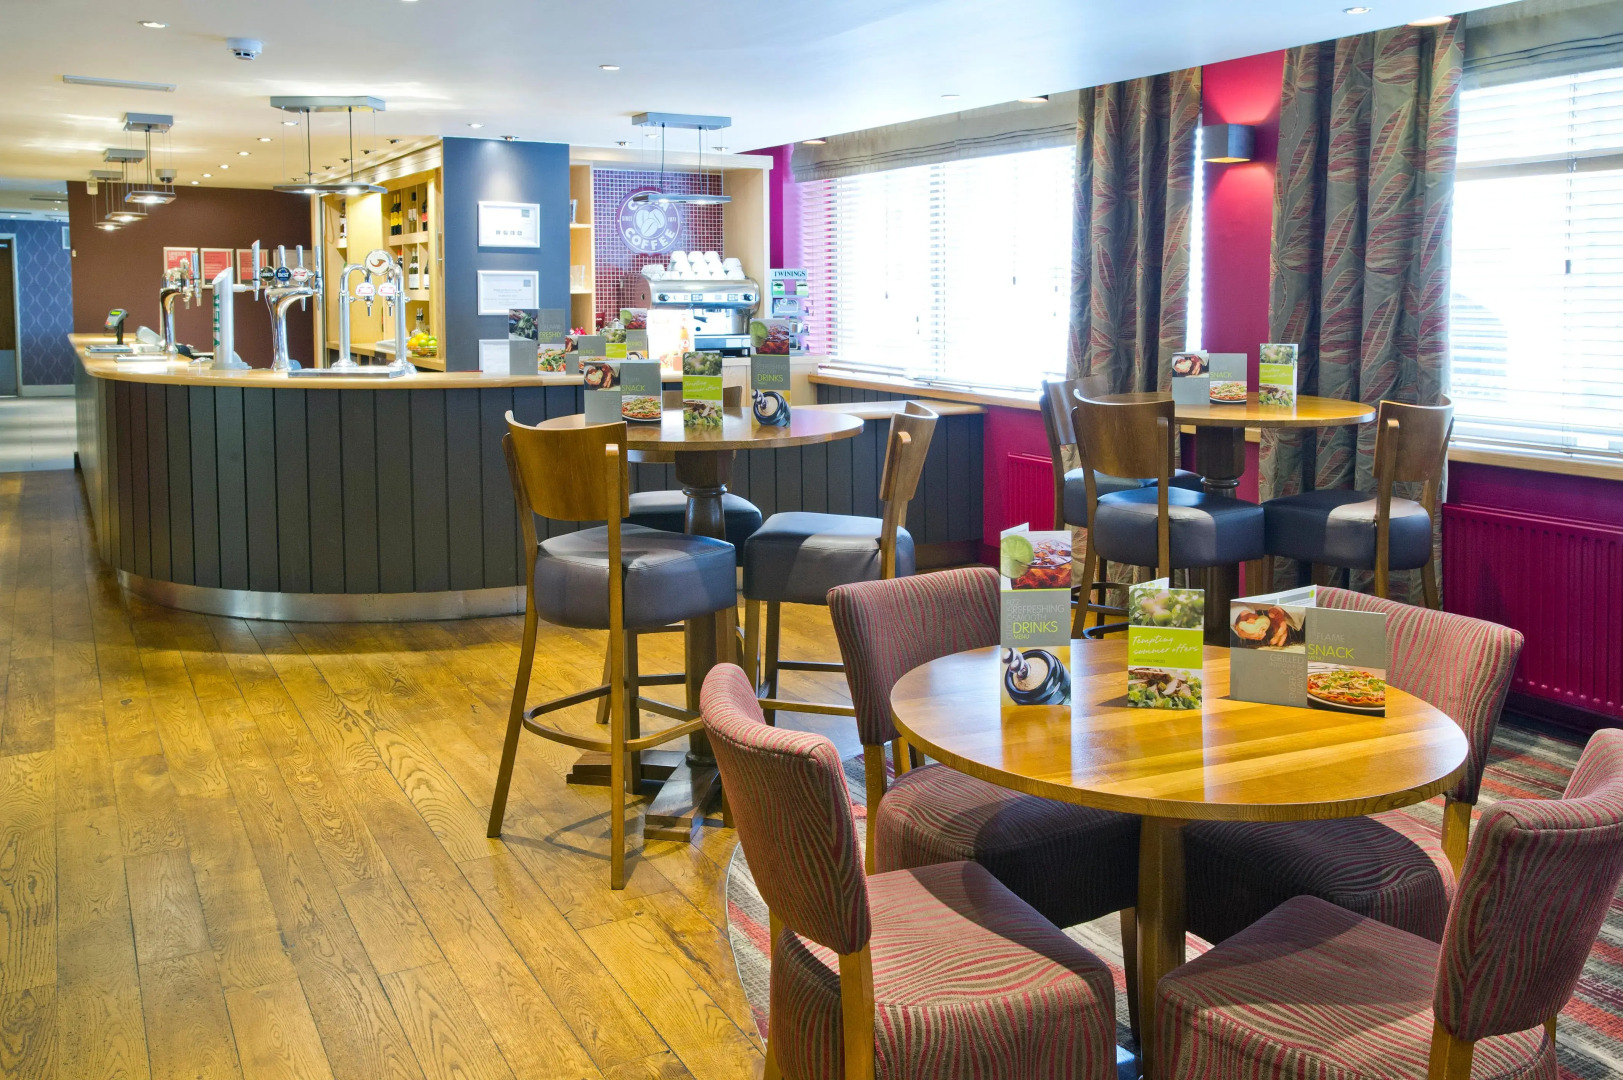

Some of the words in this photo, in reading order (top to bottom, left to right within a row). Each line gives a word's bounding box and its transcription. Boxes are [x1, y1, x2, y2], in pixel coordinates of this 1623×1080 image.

[625, 227, 675, 250] COFFEE
[757, 373, 784, 382] DRINKS
[621, 384, 645, 392] SNACK
[1011, 604, 1065, 614] REFRESHING
[1013, 620, 1058, 634] DRINKS
[1132, 635, 1174, 646] Tempting
[1316, 632, 1345, 643] FLAME
[1133, 647, 1170, 655] summer
[1172, 643, 1198, 654] offers
[1307, 643, 1354, 659] SNACK
[1269, 653, 1304, 665] GRILLED
